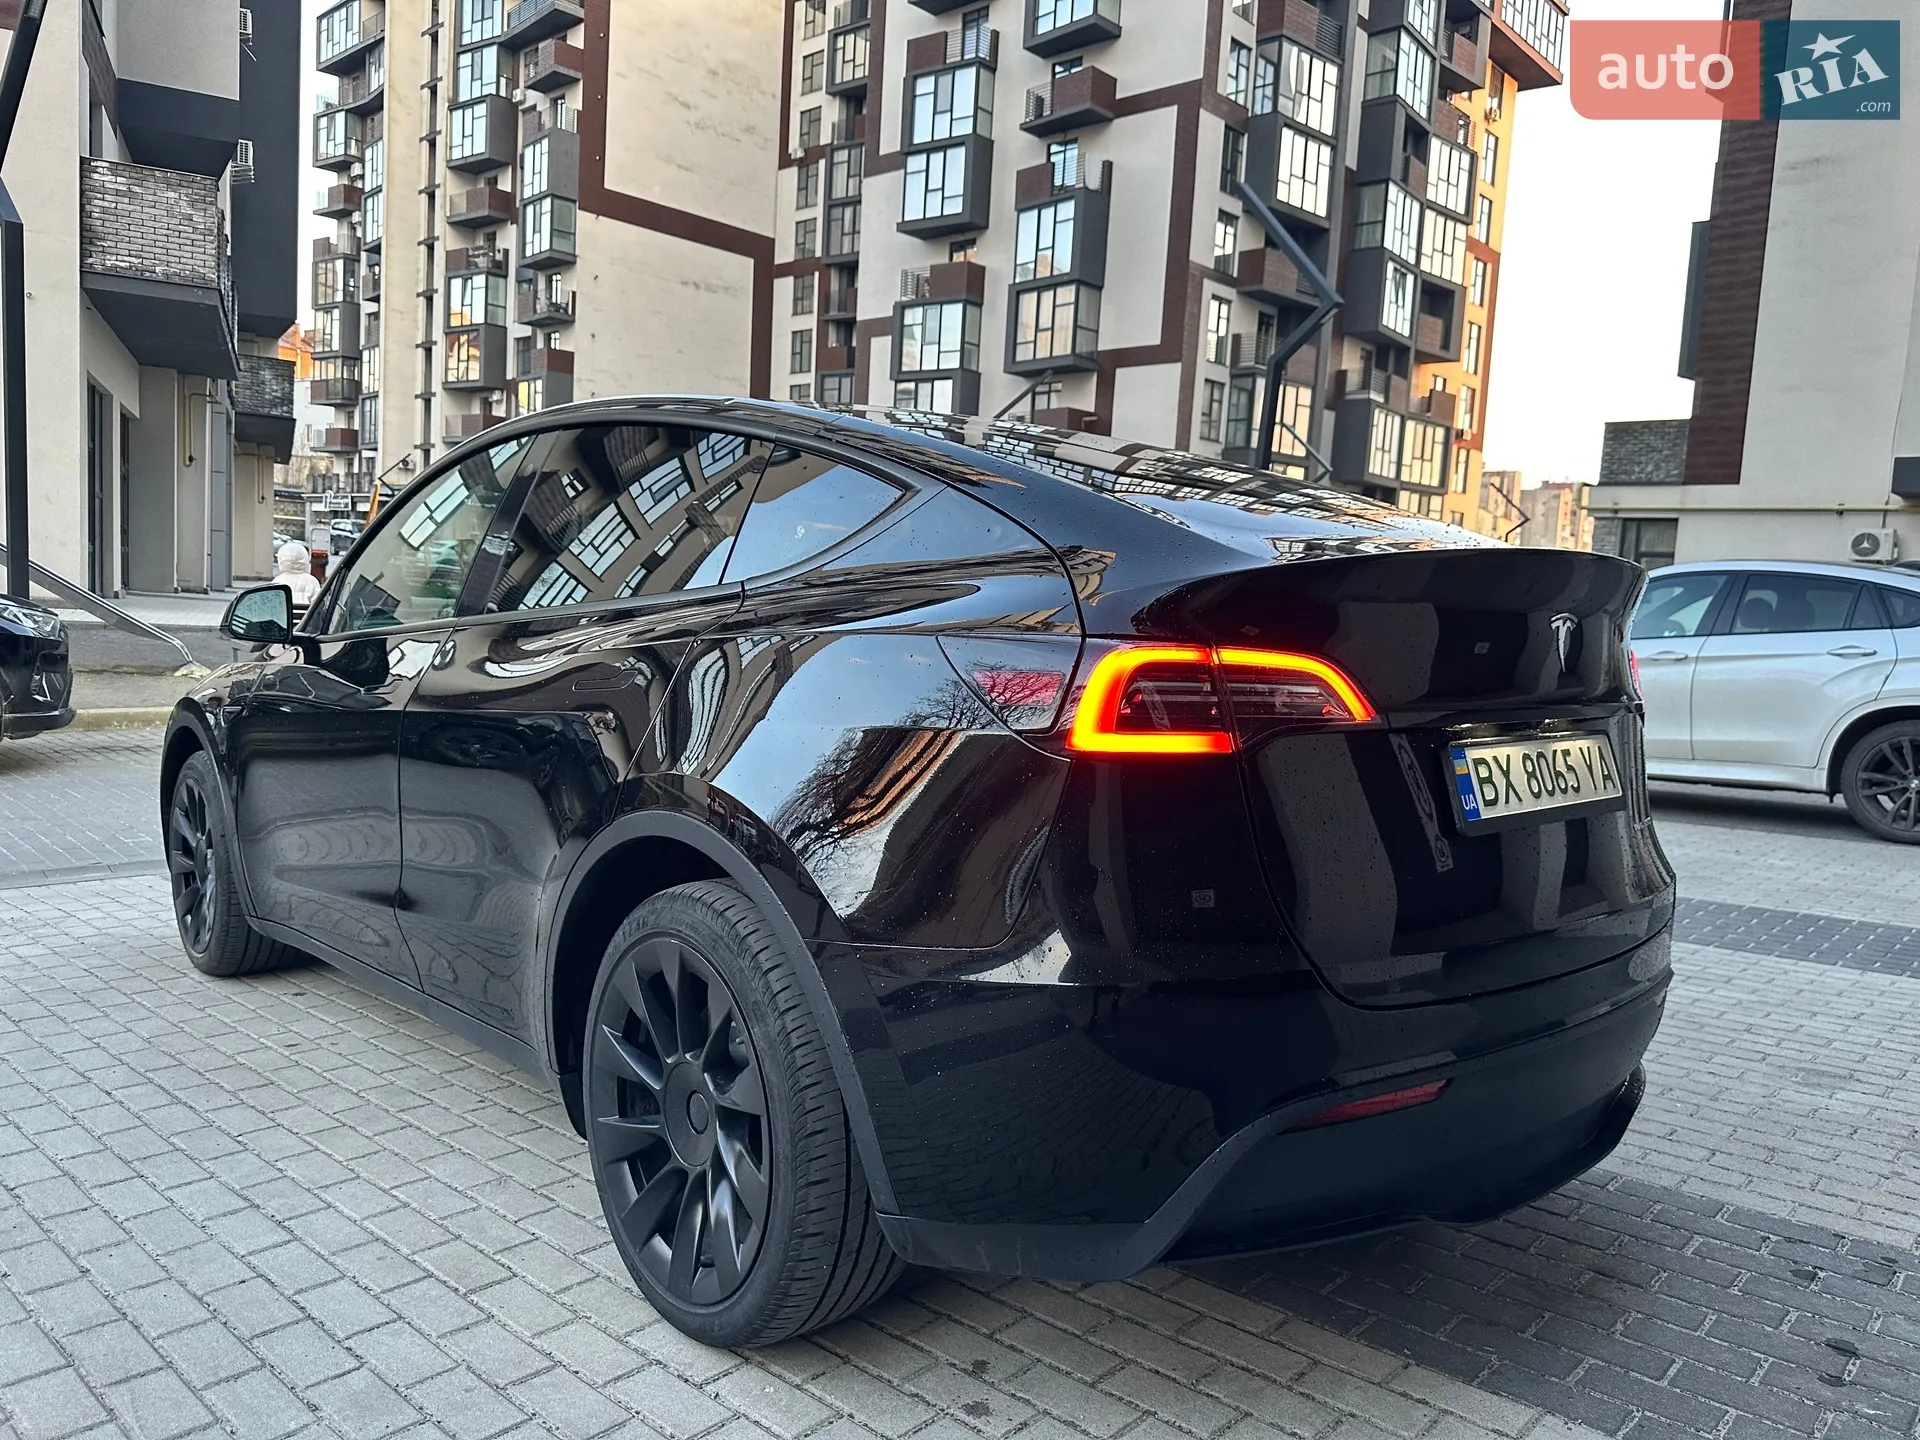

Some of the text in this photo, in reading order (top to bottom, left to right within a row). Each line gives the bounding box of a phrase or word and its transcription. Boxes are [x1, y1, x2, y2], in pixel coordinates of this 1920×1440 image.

[1472, 745, 1617, 807] BX 8065 YA
[1462, 794, 1478, 811] UA
